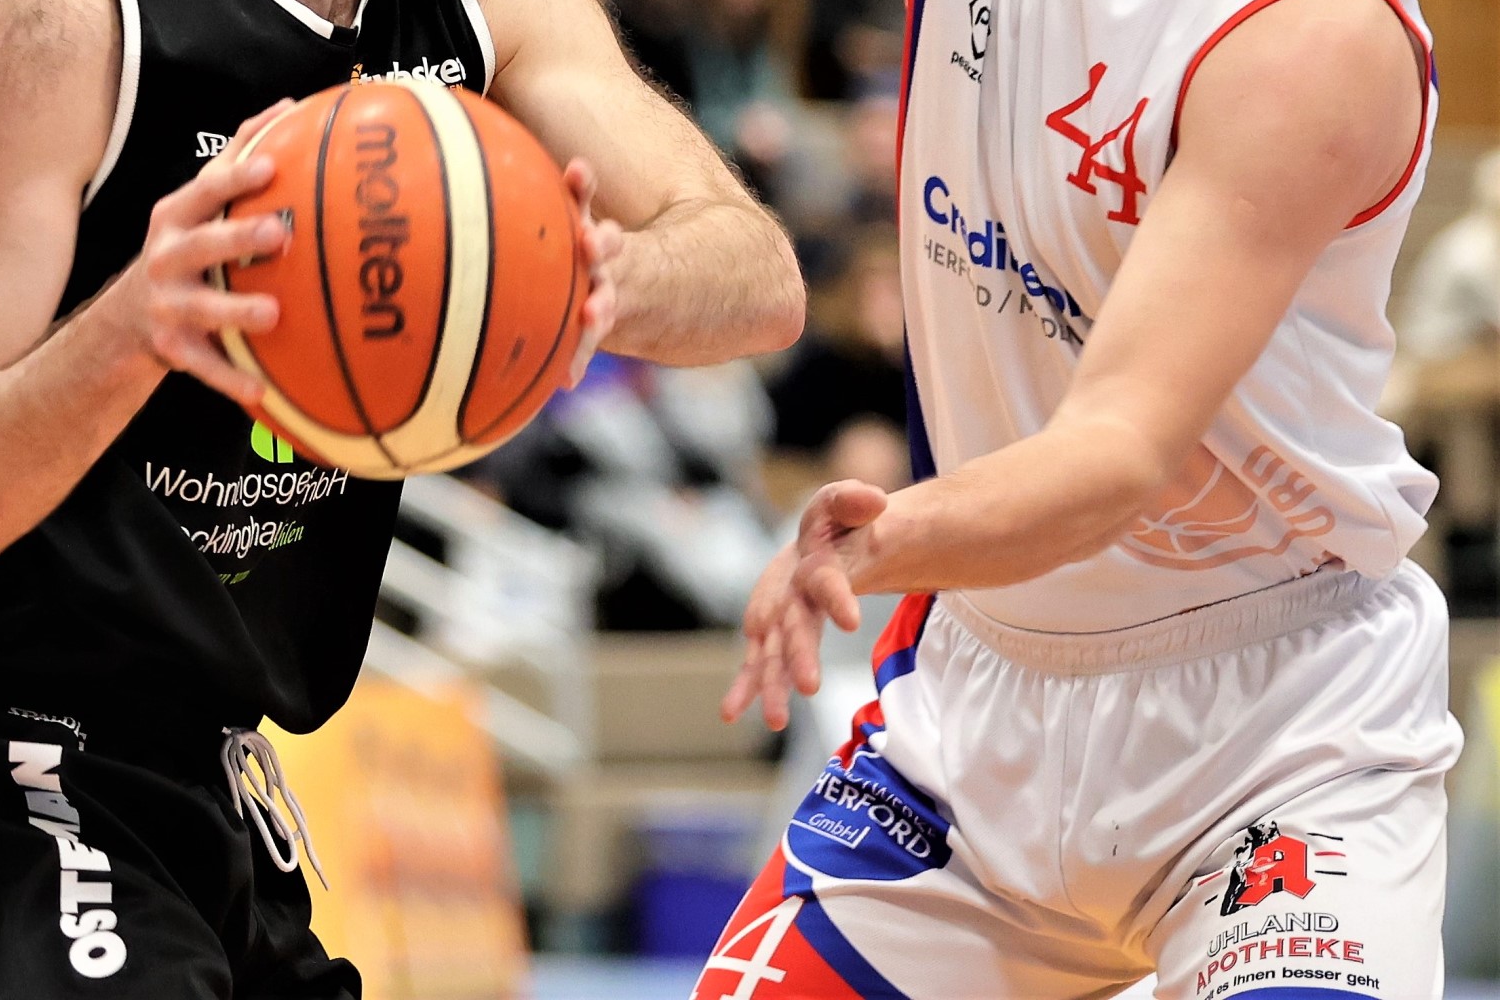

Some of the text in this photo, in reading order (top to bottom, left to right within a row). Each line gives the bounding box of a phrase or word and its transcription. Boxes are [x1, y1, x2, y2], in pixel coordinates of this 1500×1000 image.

[356, 122, 411, 340] molten
[808, 812, 860, 841] GmbH
[813, 771, 931, 859] HERFORD
[1206, 912, 1339, 957] UHLAND
[1196, 936, 1365, 996] APOTHEKE
[1216, 980, 1229, 995] es
[1233, 968, 1276, 987] Ihnen
[1282, 966, 1342, 981] besser
[1346, 972, 1380, 990] geht
